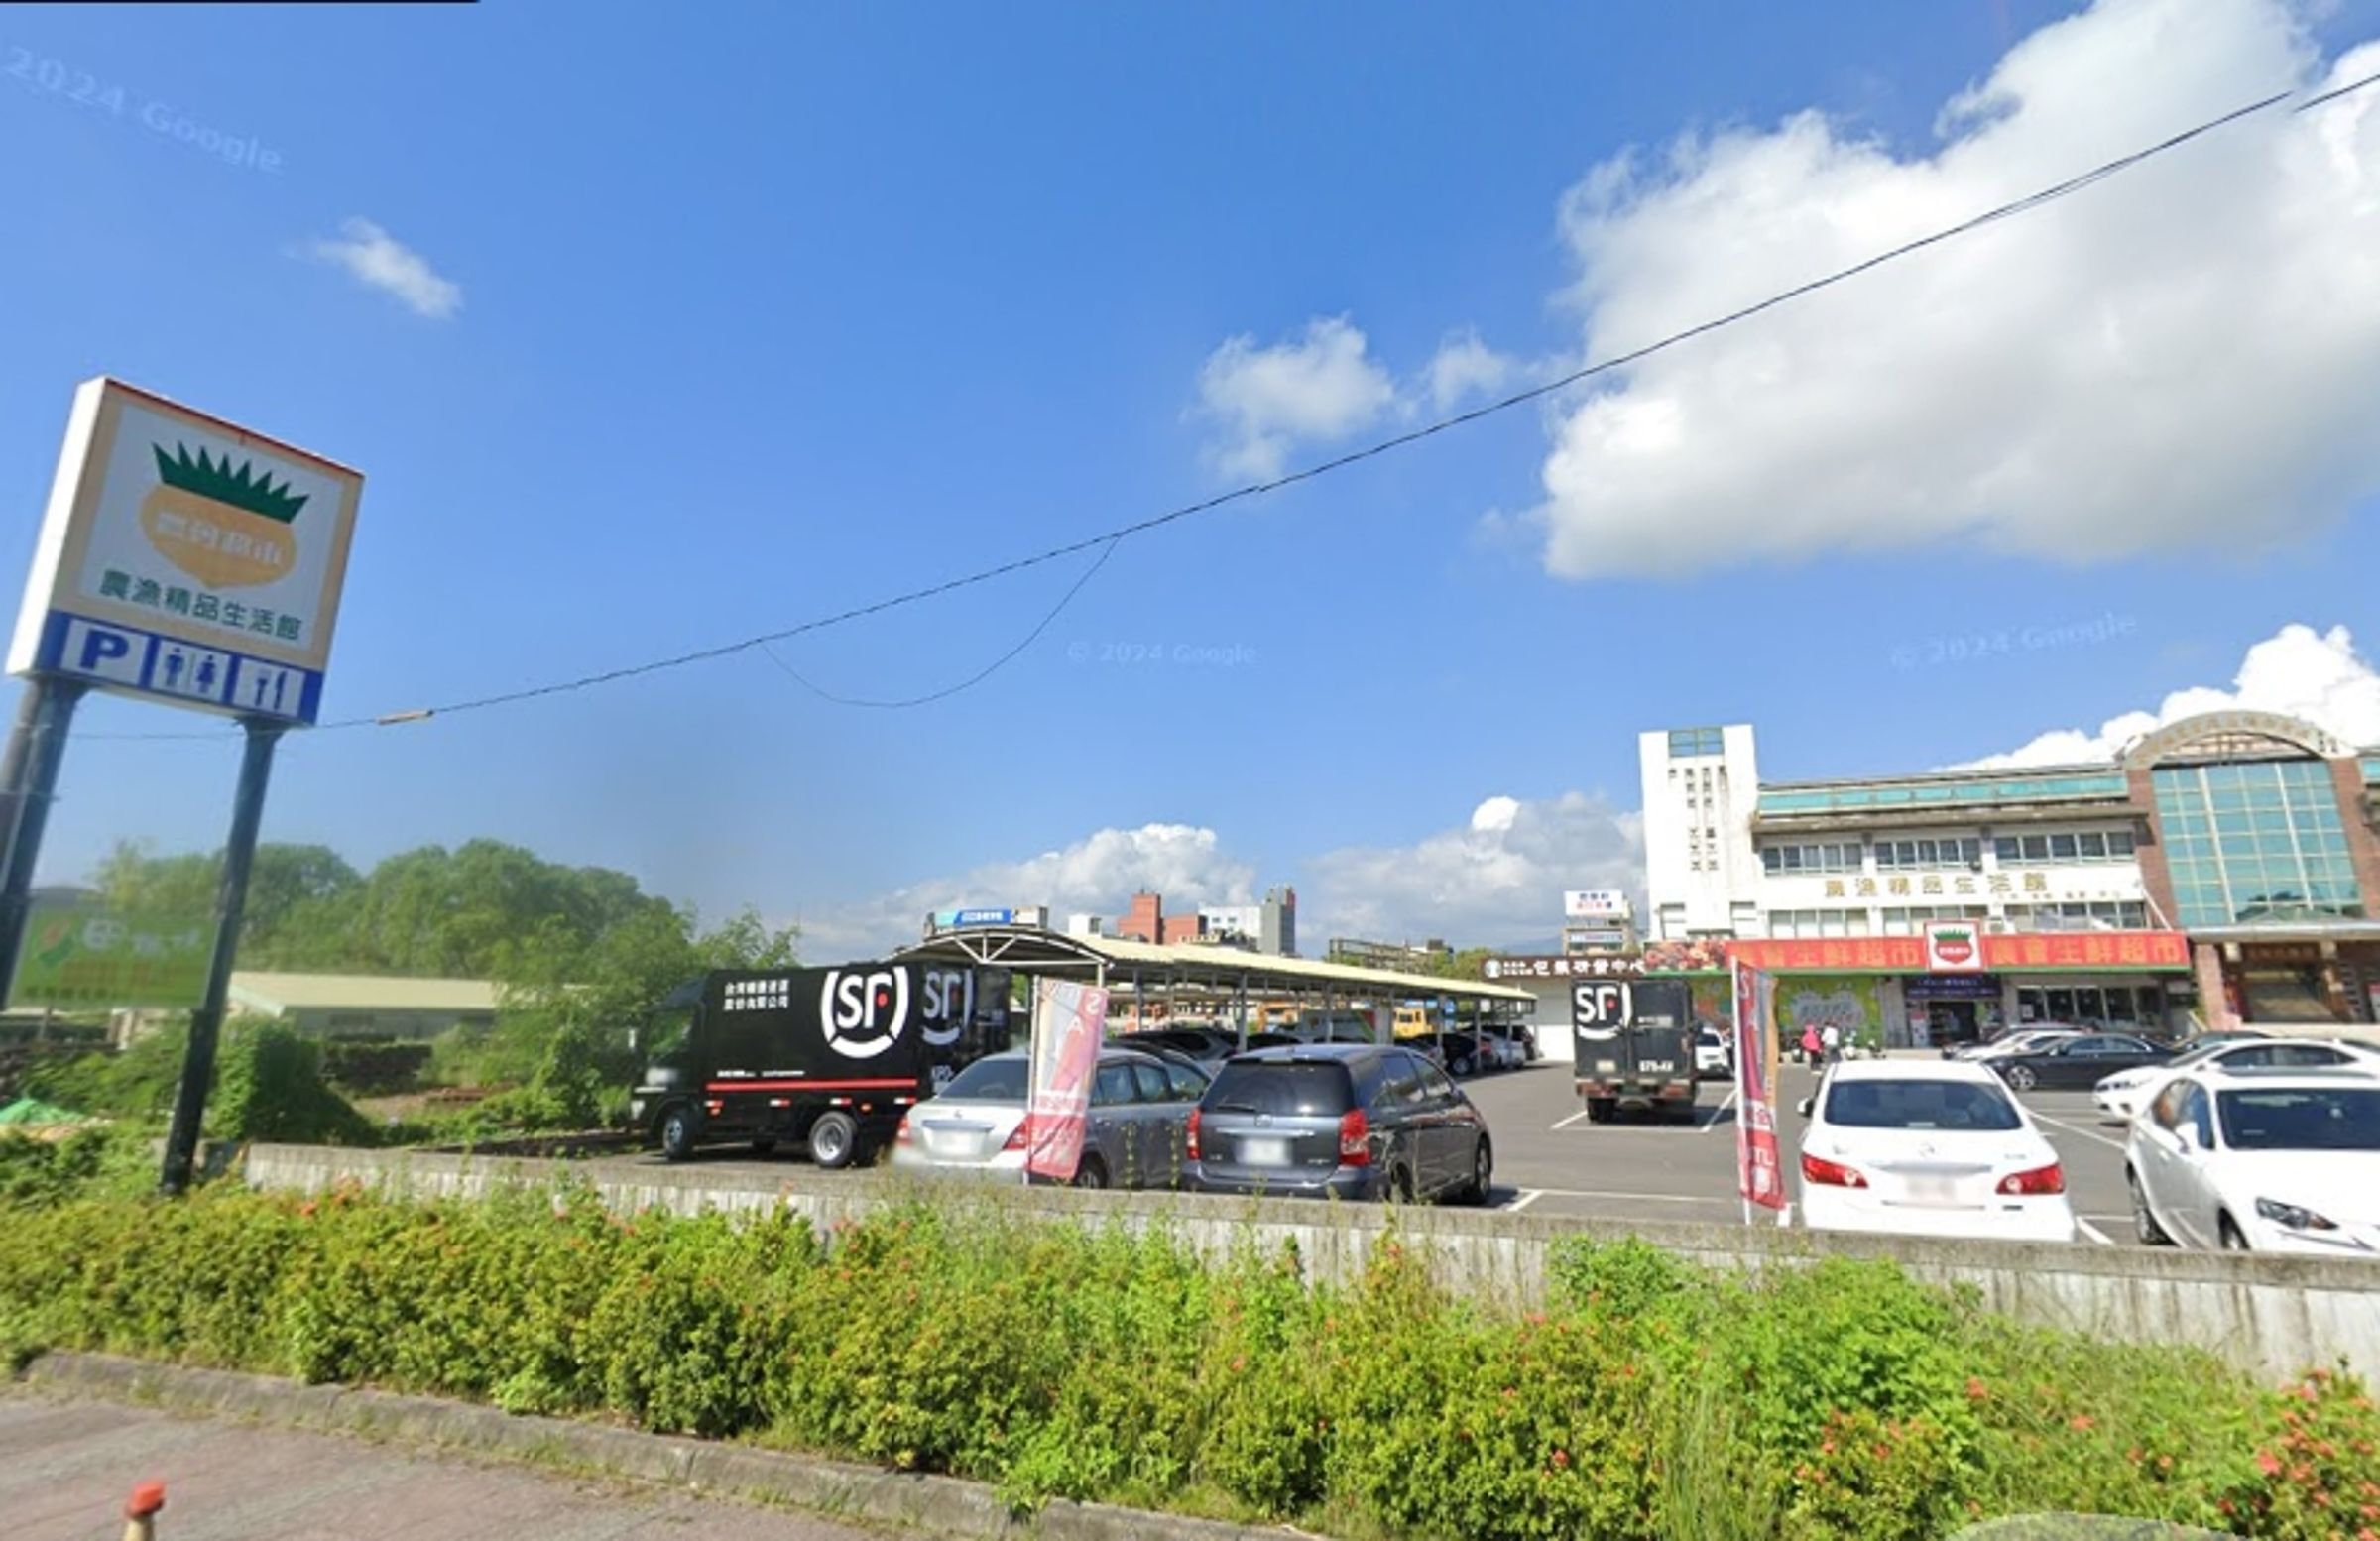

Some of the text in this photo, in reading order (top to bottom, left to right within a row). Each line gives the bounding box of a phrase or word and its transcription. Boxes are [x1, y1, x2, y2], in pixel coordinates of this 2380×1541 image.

[98, 567, 302, 641] 農漁精品生活館
[79, 628, 130, 670] P
[1825, 872, 2047, 898] 農漁精品生活館
